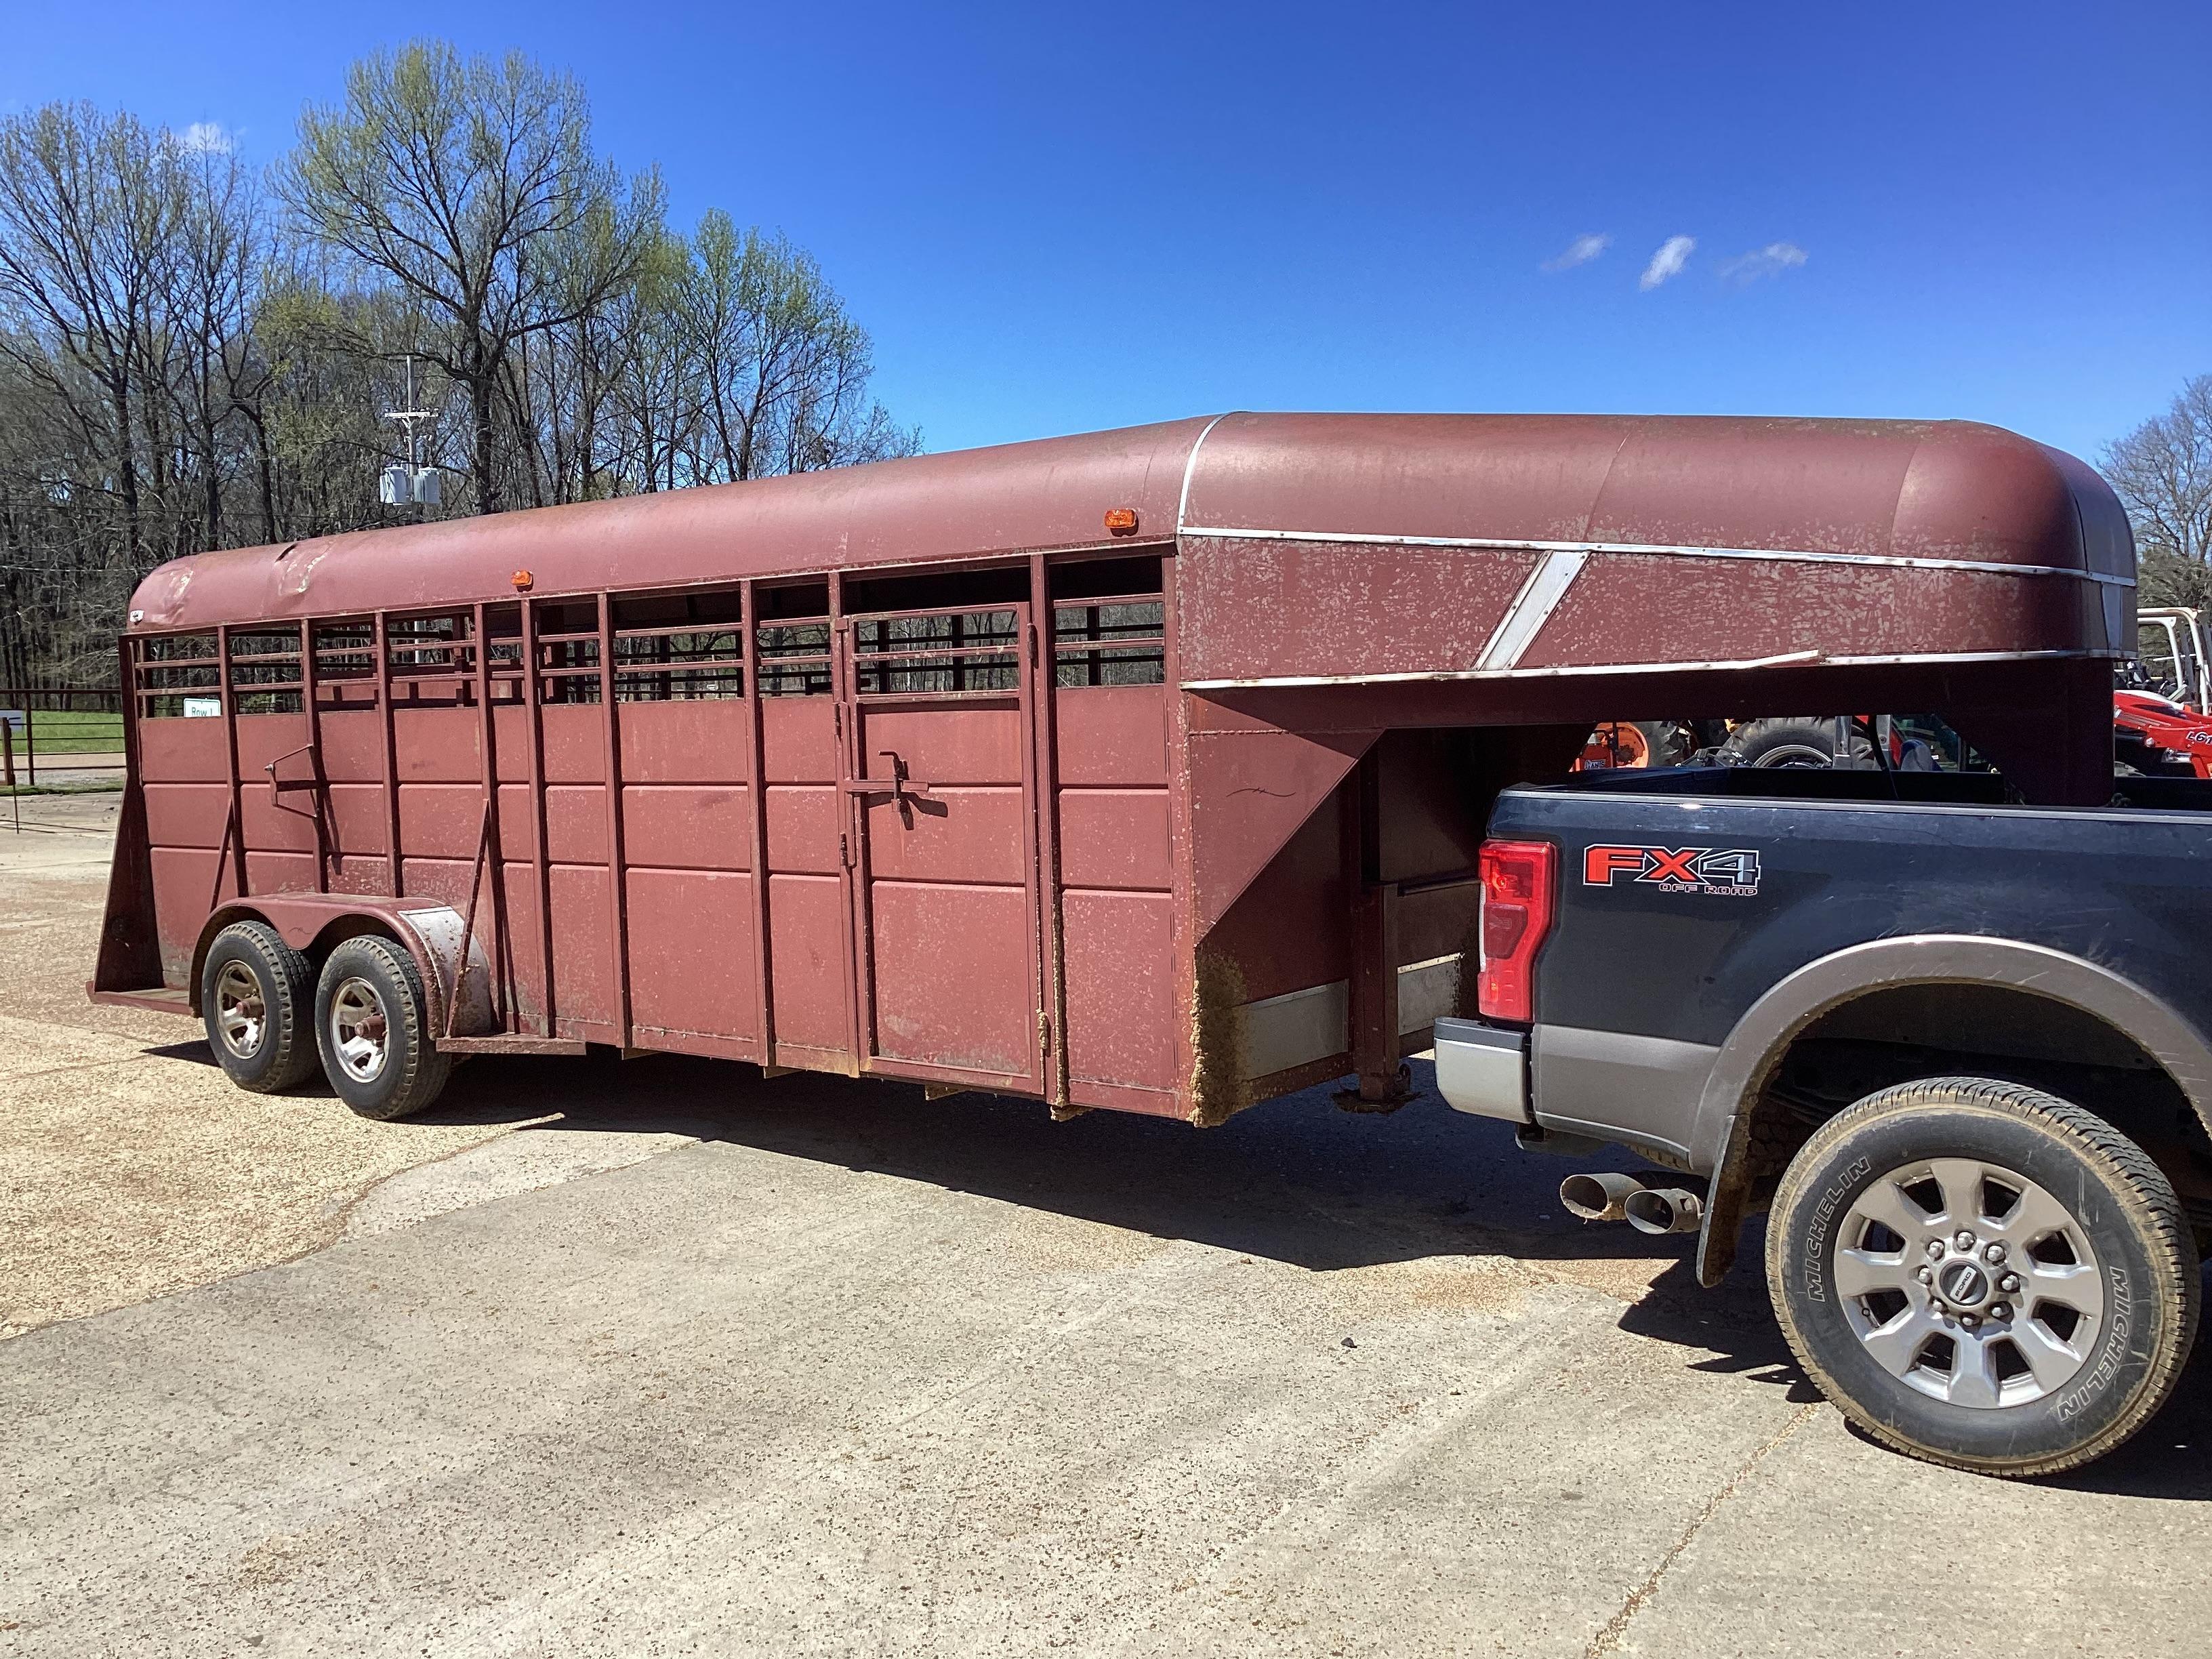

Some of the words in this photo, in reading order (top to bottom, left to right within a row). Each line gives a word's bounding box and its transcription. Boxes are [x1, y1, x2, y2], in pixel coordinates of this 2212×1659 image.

[192, 707, 207, 716] Row
[1583, 844, 1761, 888] FX4
[1659, 883, 1698, 893] OFF
[1704, 885, 1757, 896] ROAD
[1805, 1156, 1871, 1303] MICHELIN
[1954, 1272, 1971, 1297] FORD
[2057, 1266, 2131, 1422] MICHELIN
